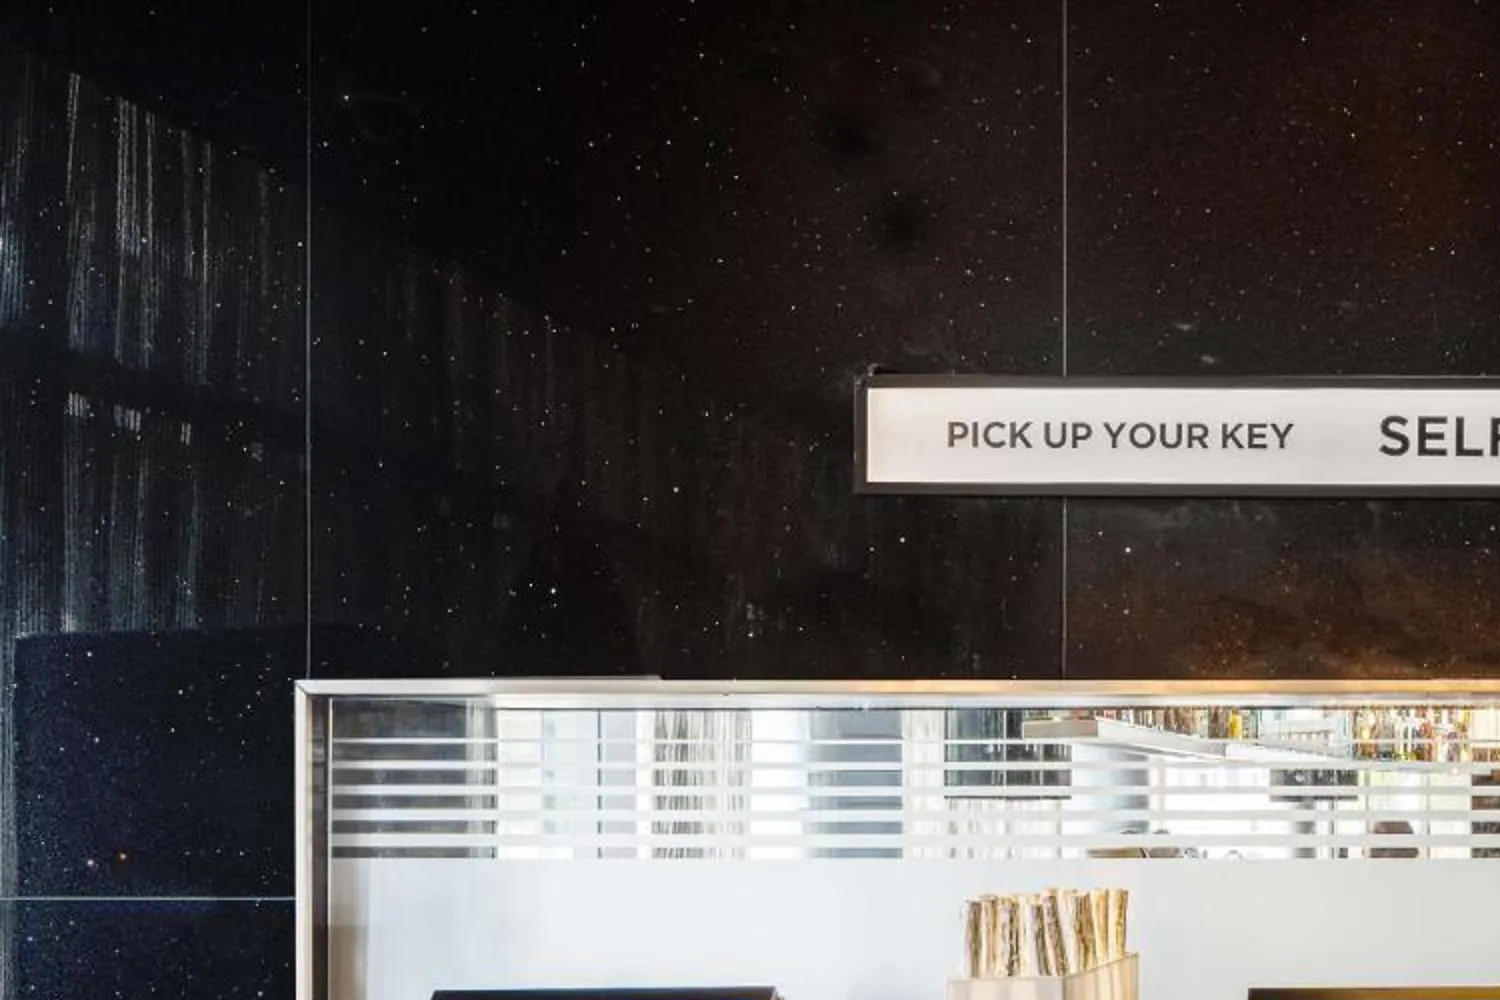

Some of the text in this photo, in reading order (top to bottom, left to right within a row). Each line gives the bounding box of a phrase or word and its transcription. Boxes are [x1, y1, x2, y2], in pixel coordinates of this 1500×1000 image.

[948, 421, 1294, 450] PICK UP YOUR KEY
